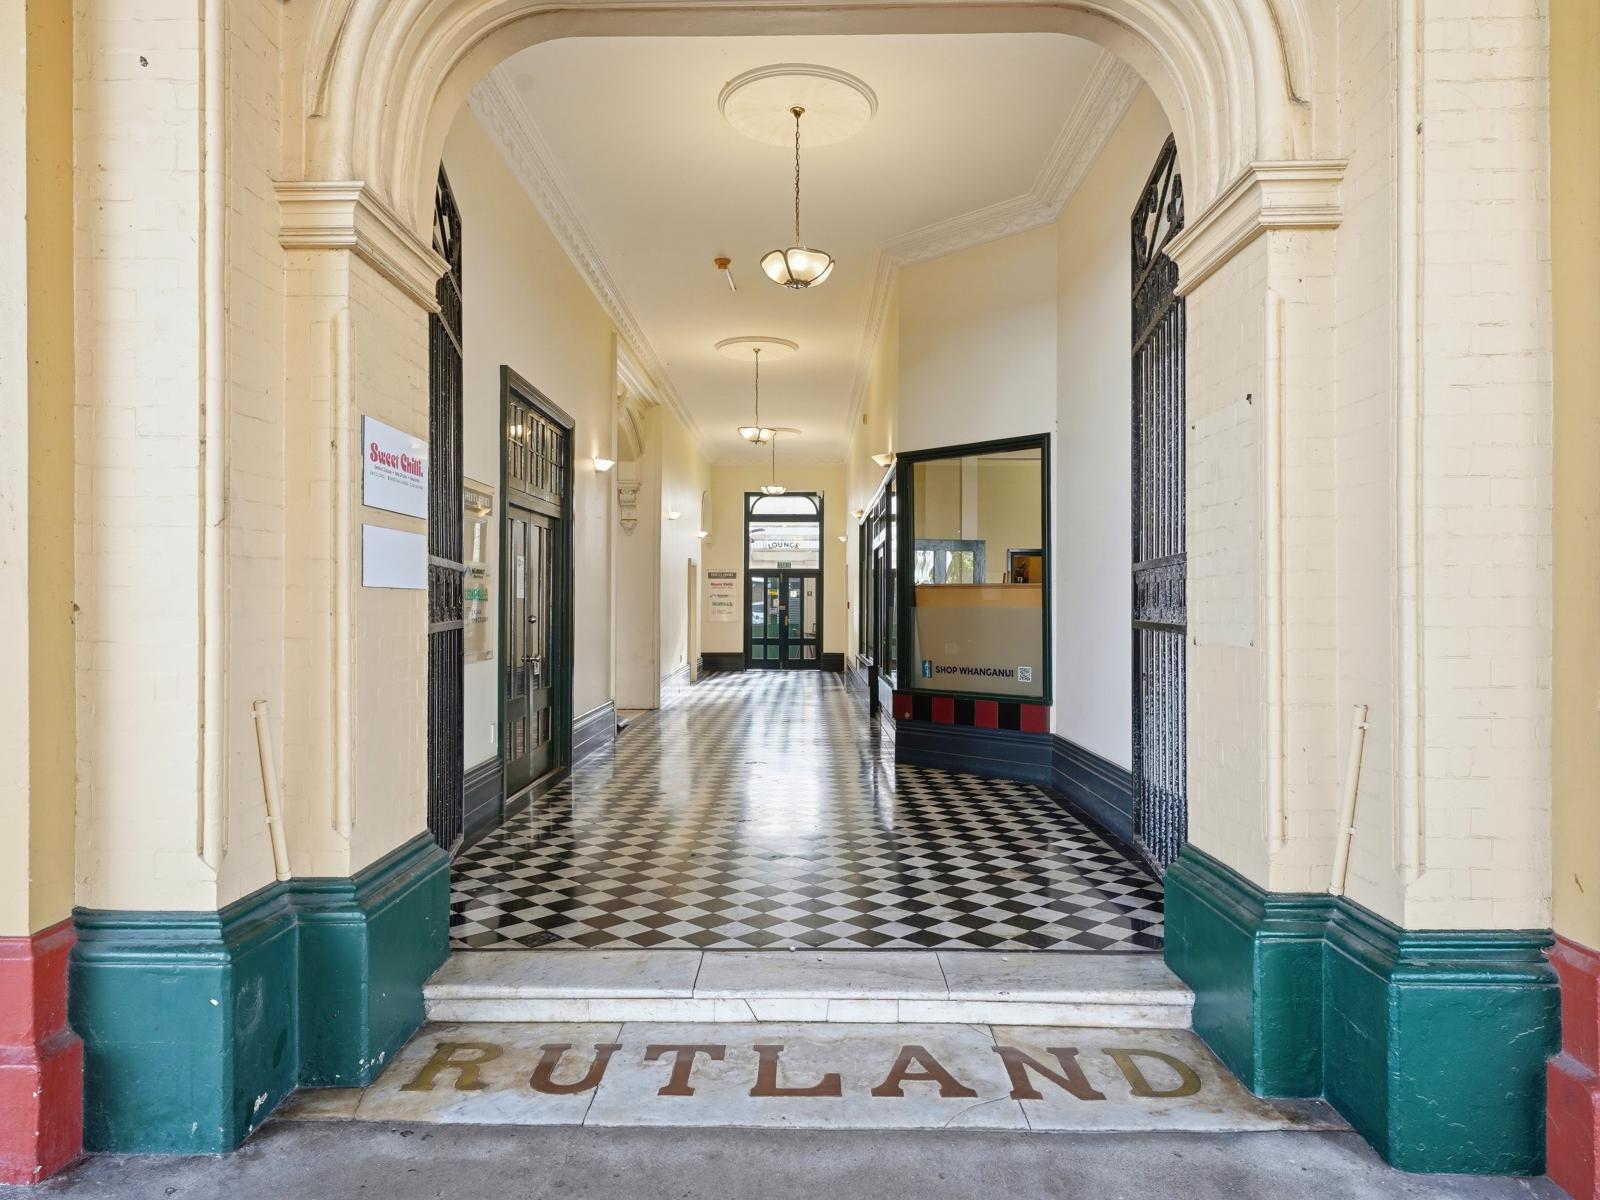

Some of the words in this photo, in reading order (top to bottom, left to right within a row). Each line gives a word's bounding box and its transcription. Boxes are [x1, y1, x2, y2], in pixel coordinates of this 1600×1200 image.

[370, 442, 399, 469] Sweet
[767, 541, 800, 550] LOUNGE
[935, 665, 958, 674] SHOP
[959, 666, 1014, 677] WHANGANUI
[400, 1042, 1202, 1100] RUTLAND
